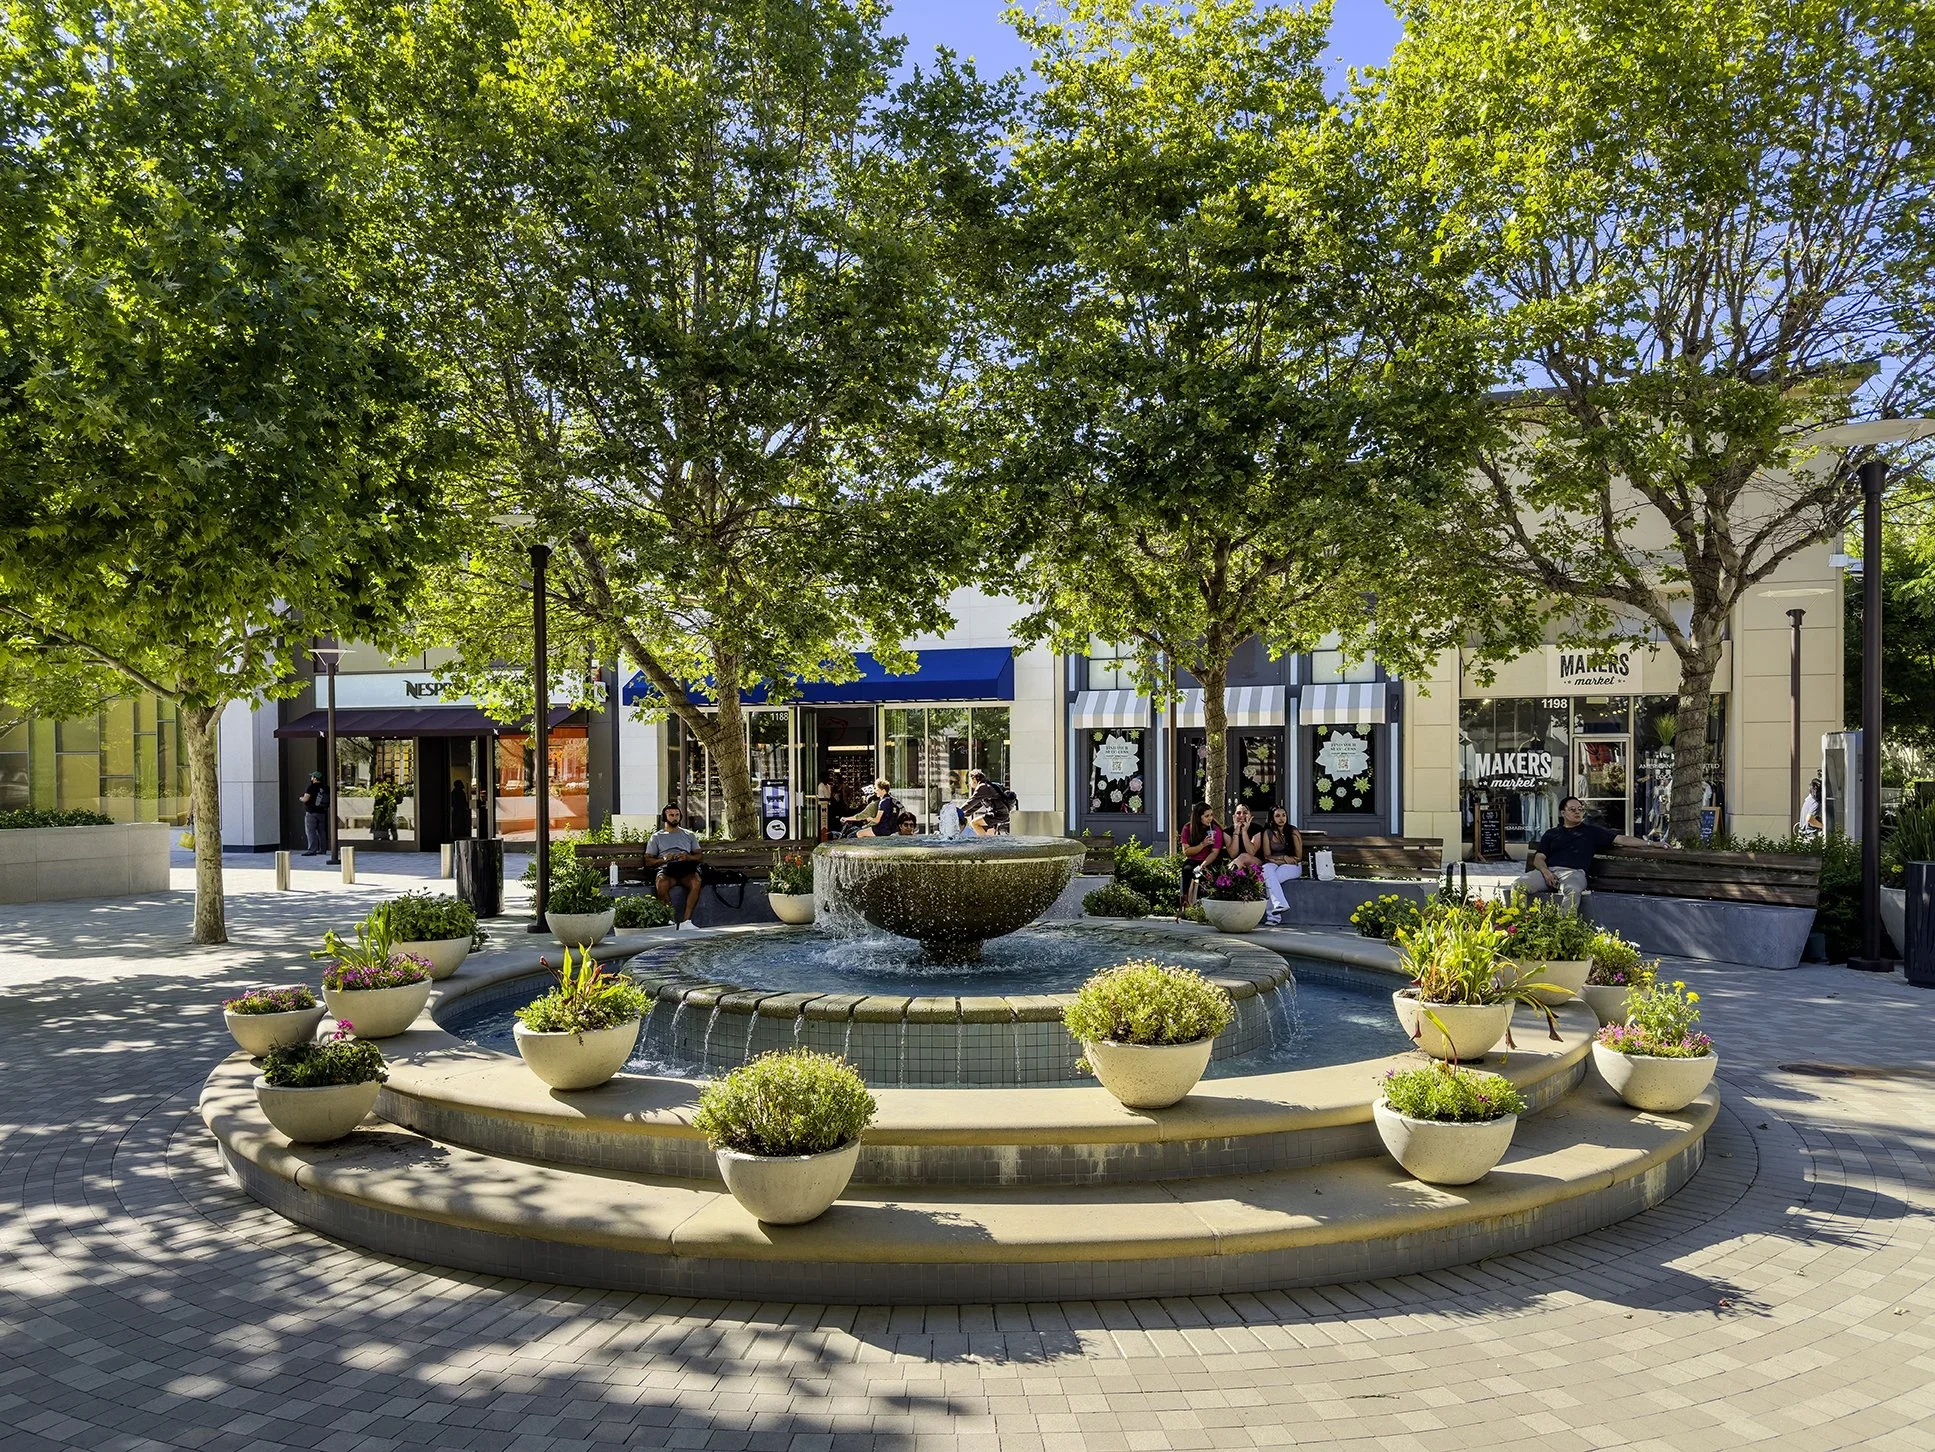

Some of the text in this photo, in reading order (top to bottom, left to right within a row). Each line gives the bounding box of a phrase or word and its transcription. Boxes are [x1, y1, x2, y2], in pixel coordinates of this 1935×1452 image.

[1574, 676, 1615, 685] market
[1541, 698, 1568, 709] 1198
[770, 712, 789, 721] 1188
[1475, 752, 1552, 779] MAKERS
[1490, 777, 1536, 788] market
